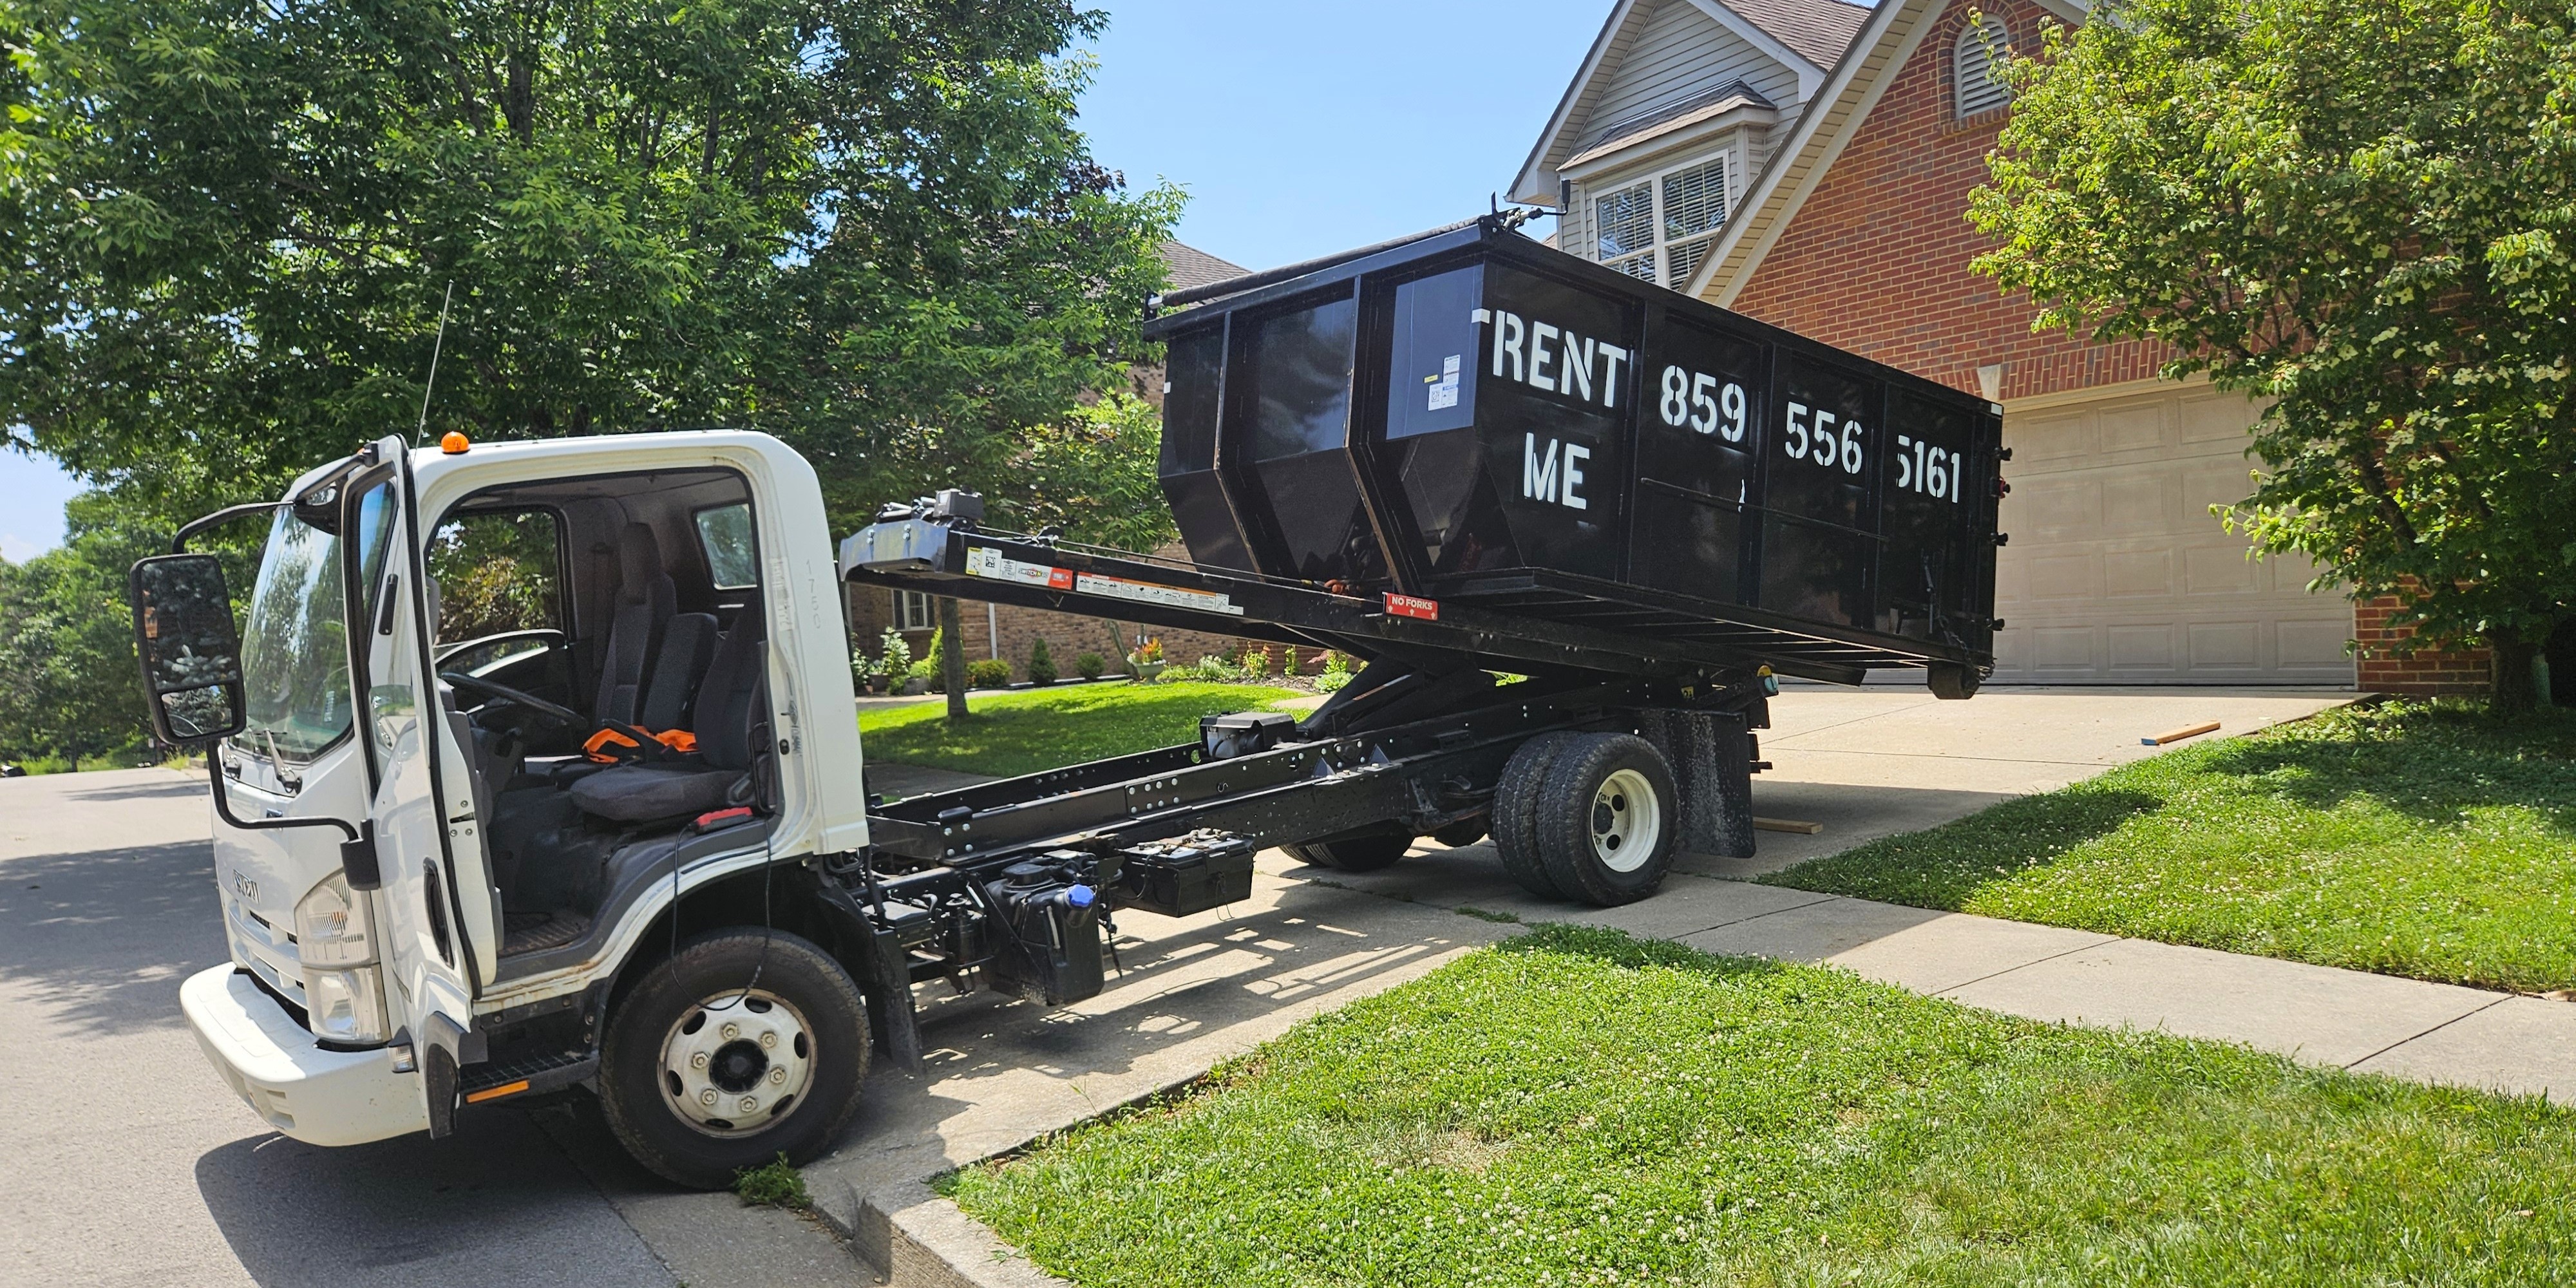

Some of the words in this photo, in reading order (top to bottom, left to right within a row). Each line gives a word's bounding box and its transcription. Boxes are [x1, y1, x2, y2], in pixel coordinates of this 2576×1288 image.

[1493, 310, 1627, 408] RENT
[1524, 432, 1590, 510] ME
[1660, 365, 1746, 442] 859
[1785, 401, 1862, 474] 556
[1896, 435, 1960, 503] 5161
[1392, 596, 1405, 606] NO
[1405, 598, 1433, 611] FORKS
